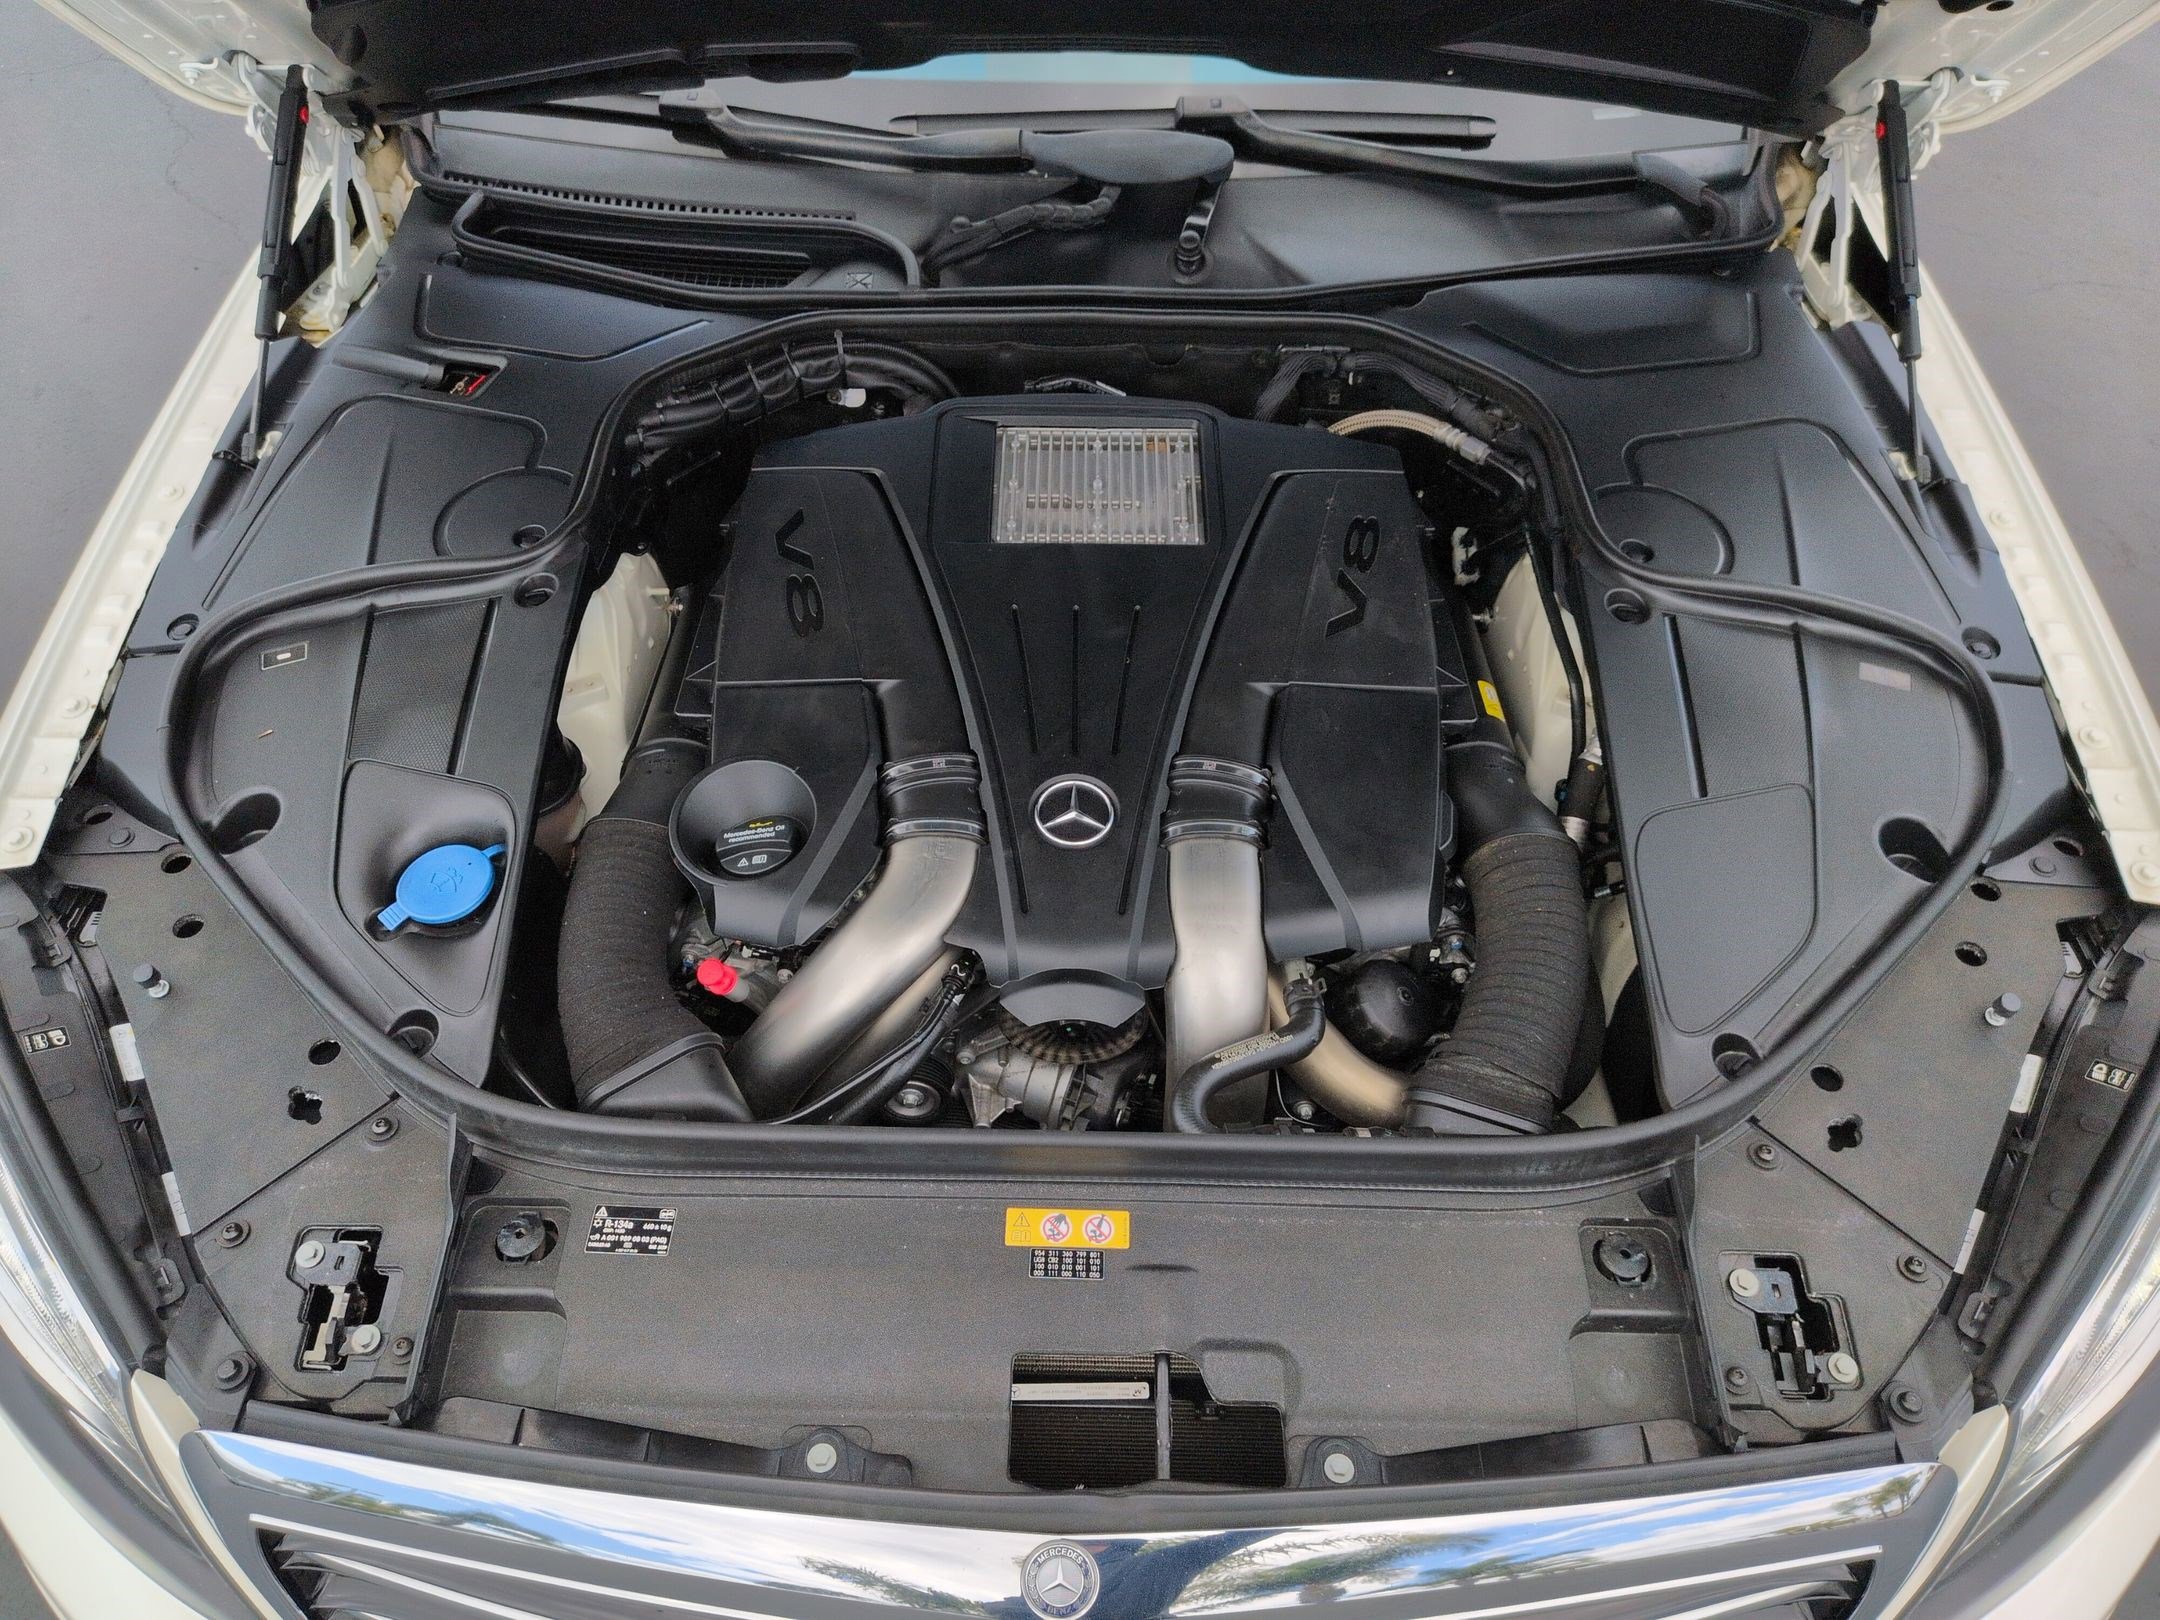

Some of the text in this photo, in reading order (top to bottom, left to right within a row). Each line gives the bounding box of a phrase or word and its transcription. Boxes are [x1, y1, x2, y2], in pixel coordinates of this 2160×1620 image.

[774, 507, 825, 638] V8
[1324, 515, 1381, 638] V8
[728, 831, 775, 843] recommended
[604, 1219, 634, 1229] R-134a
[1037, 1547, 1084, 1564] MERCEDES
